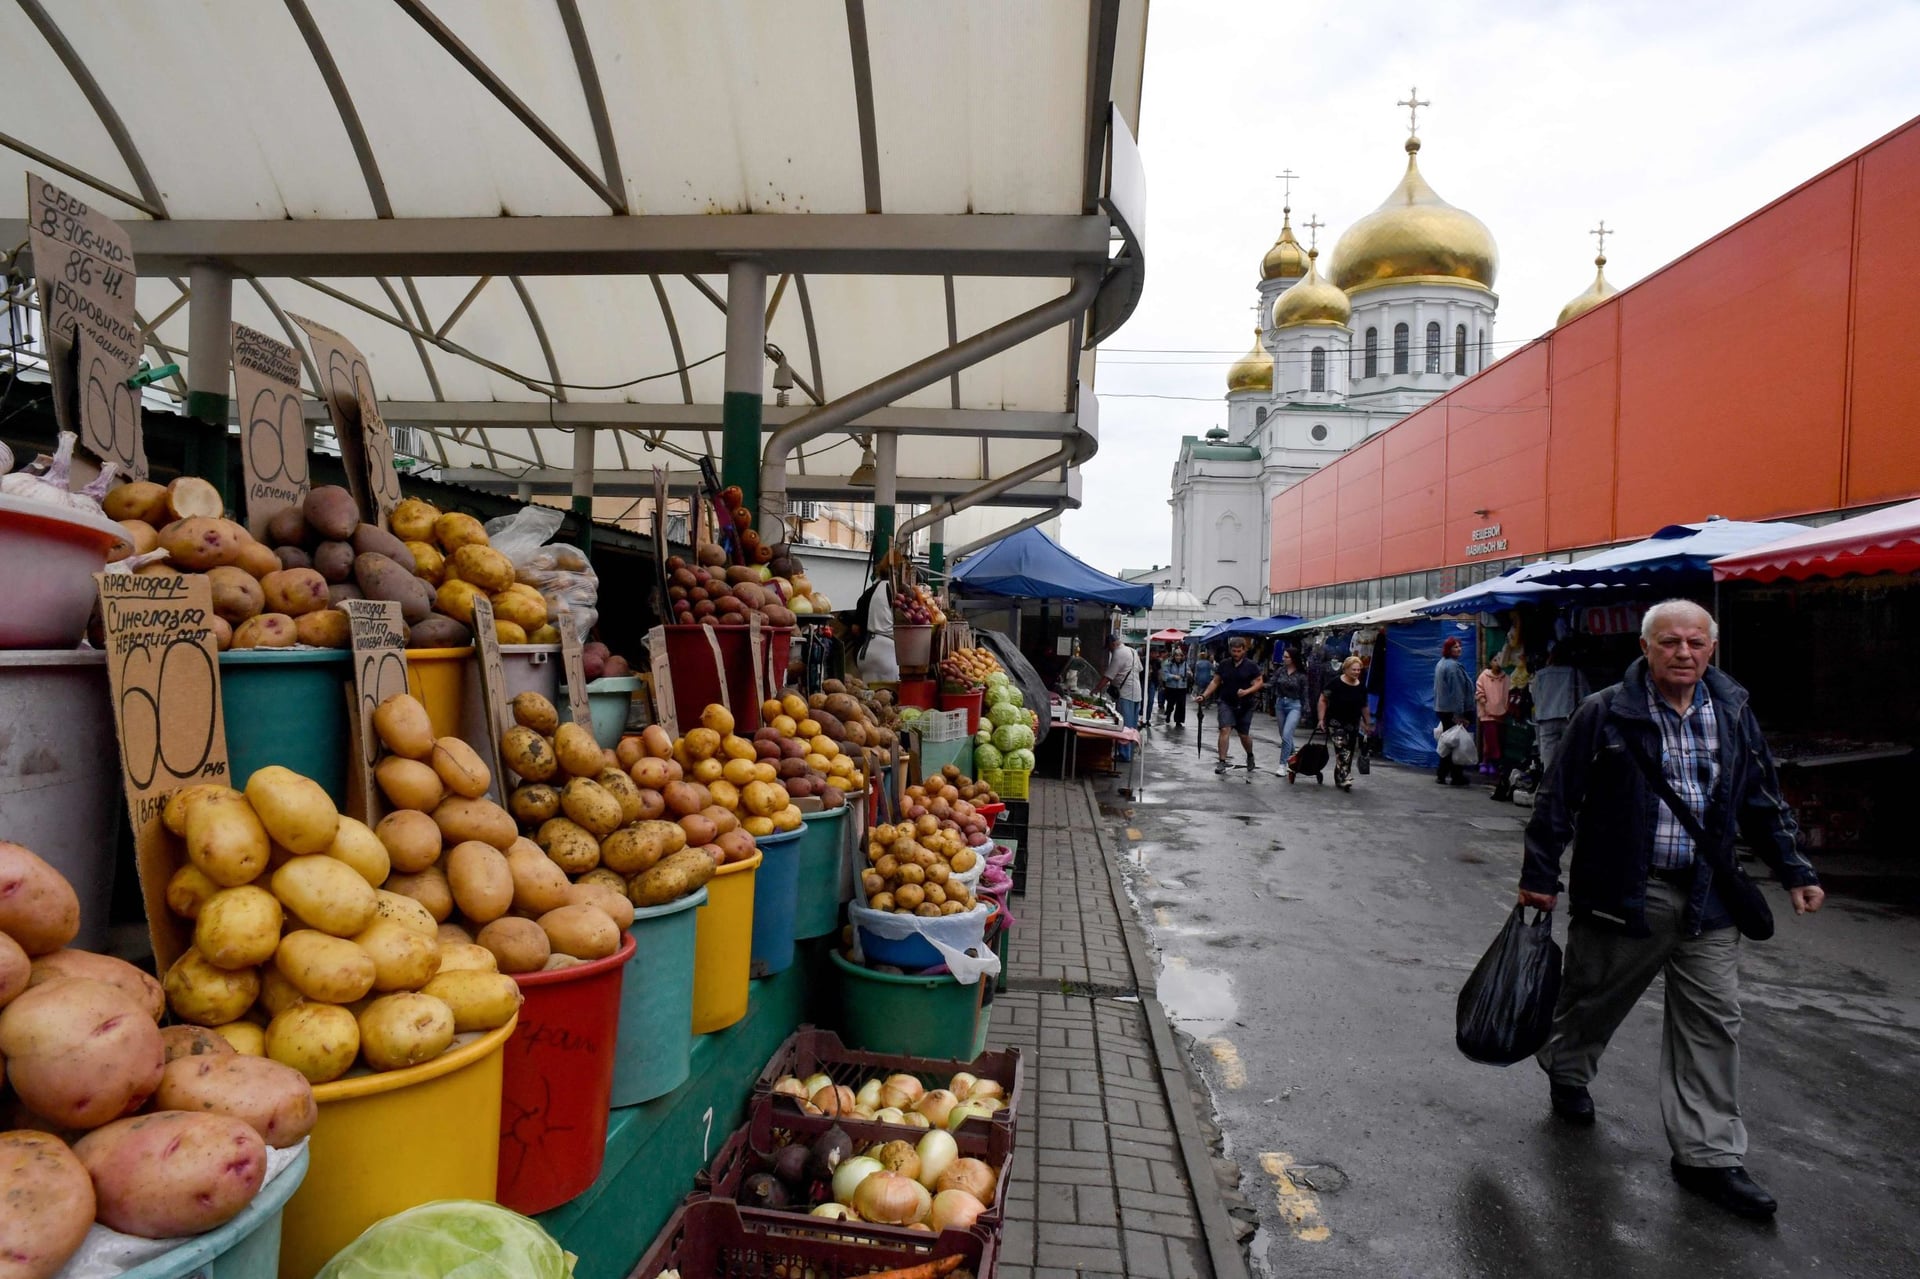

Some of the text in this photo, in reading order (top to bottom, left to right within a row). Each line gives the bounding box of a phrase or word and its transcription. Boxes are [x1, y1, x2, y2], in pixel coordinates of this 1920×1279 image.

[41, 183, 87, 216] СБЕР
[87, 357, 136, 468] 60
[248, 388, 308, 484] 60
[1465, 540, 1496, 556] ПАВИЛЬОН
[107, 601, 205, 634] Синеглазка
[120, 637, 217, 790] 60
